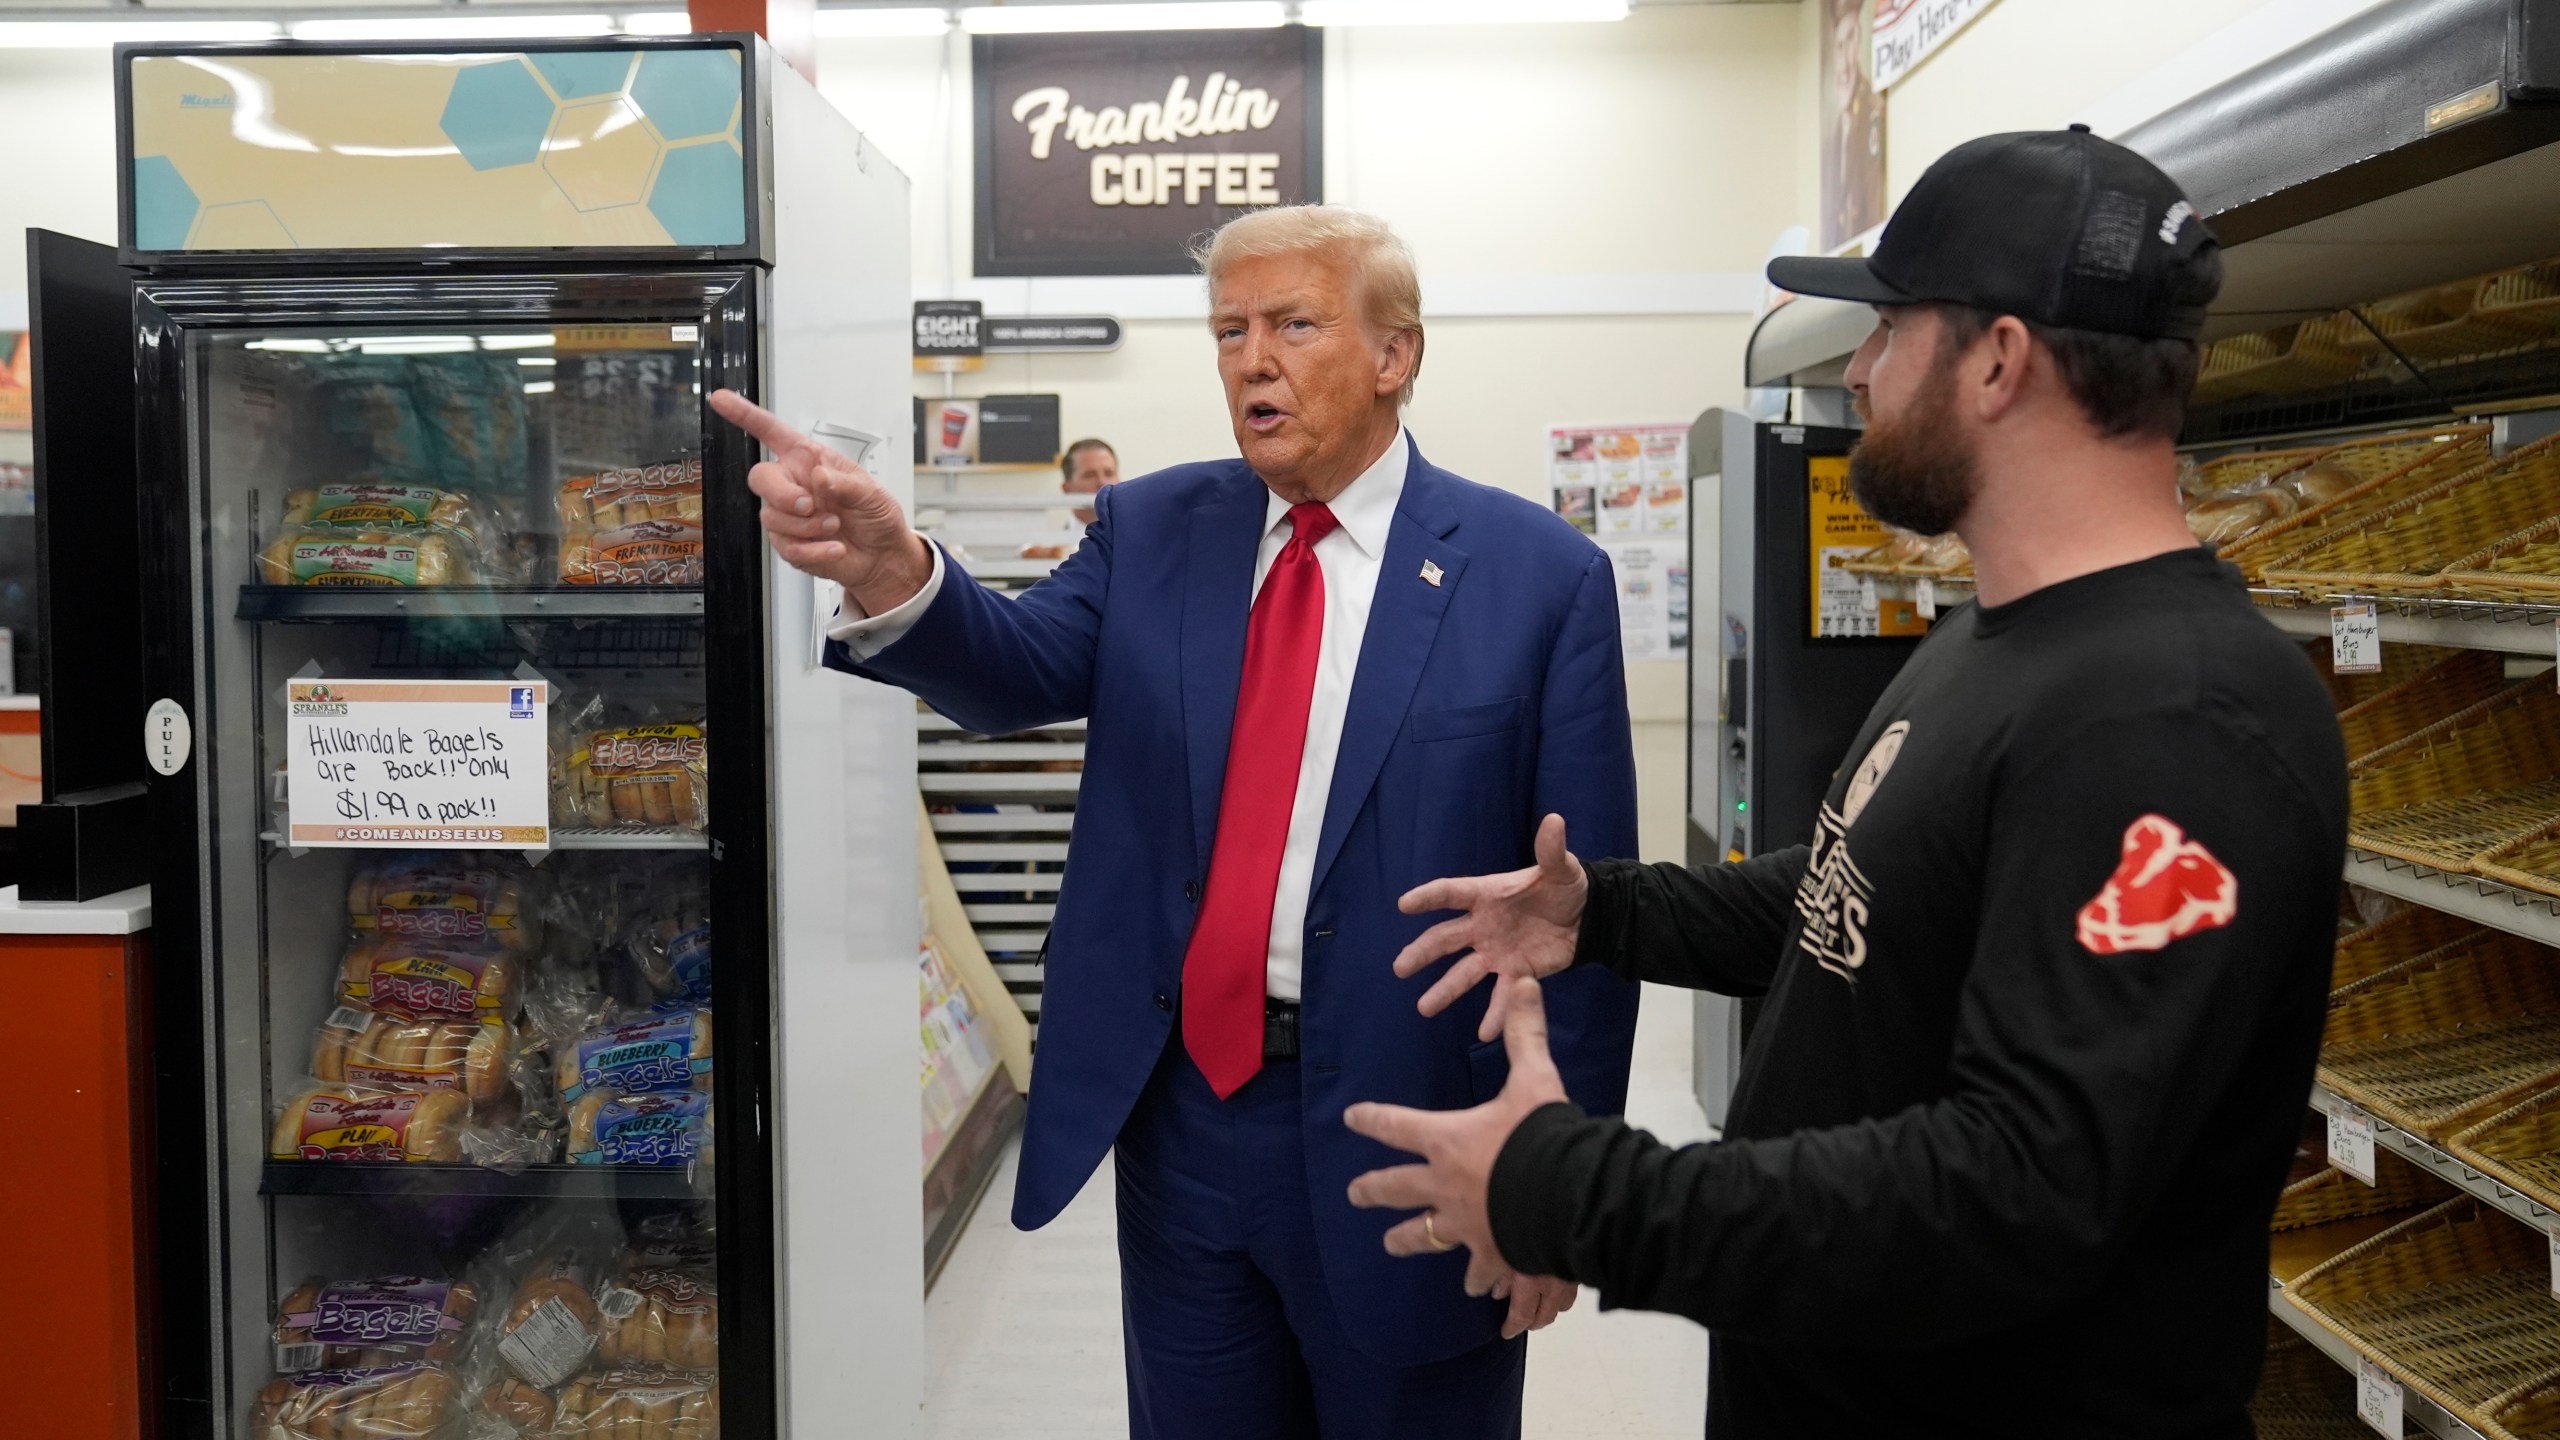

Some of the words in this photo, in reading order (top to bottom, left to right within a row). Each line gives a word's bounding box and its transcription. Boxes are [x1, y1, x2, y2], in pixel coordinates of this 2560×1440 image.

[1875, 34, 1913, 77] Play
[1918, 4, 1957, 49] Here
[1012, 71, 1280, 160] Franklin
[1090, 152, 1281, 206] COFFEE
[915, 315, 980, 335] EIGHT
[330, 506, 404, 520] EVERYTHING
[1827, 514, 1849, 522] WIN
[1825, 525, 1857, 533] GAME
[616, 546, 660, 561] FRENCH
[662, 543, 697, 555] TOAST
[293, 703, 348, 715] SPRANKLE'S
[162, 717, 172, 768] PULL
[309, 724, 413, 756] Hillandale
[424, 726, 503, 765] Bagels
[588, 736, 707, 769] Bagels
[317, 760, 356, 782] are
[336, 788, 409, 821] $1.99
[417, 802, 432, 820] a
[438, 797, 496, 824] pack!!
[336, 828, 503, 841] #COMEANDSEEUS
[409, 894, 452, 906] PLAIN
[376, 904, 487, 938] Bagels
[406, 959, 449, 976] PLAIN
[369, 971, 477, 1013] Bagels
[598, 1042, 670, 1067] BLUEBERRY
[580, 1056, 692, 1092] Bagels
[311, 1301, 442, 1339] Bagels
